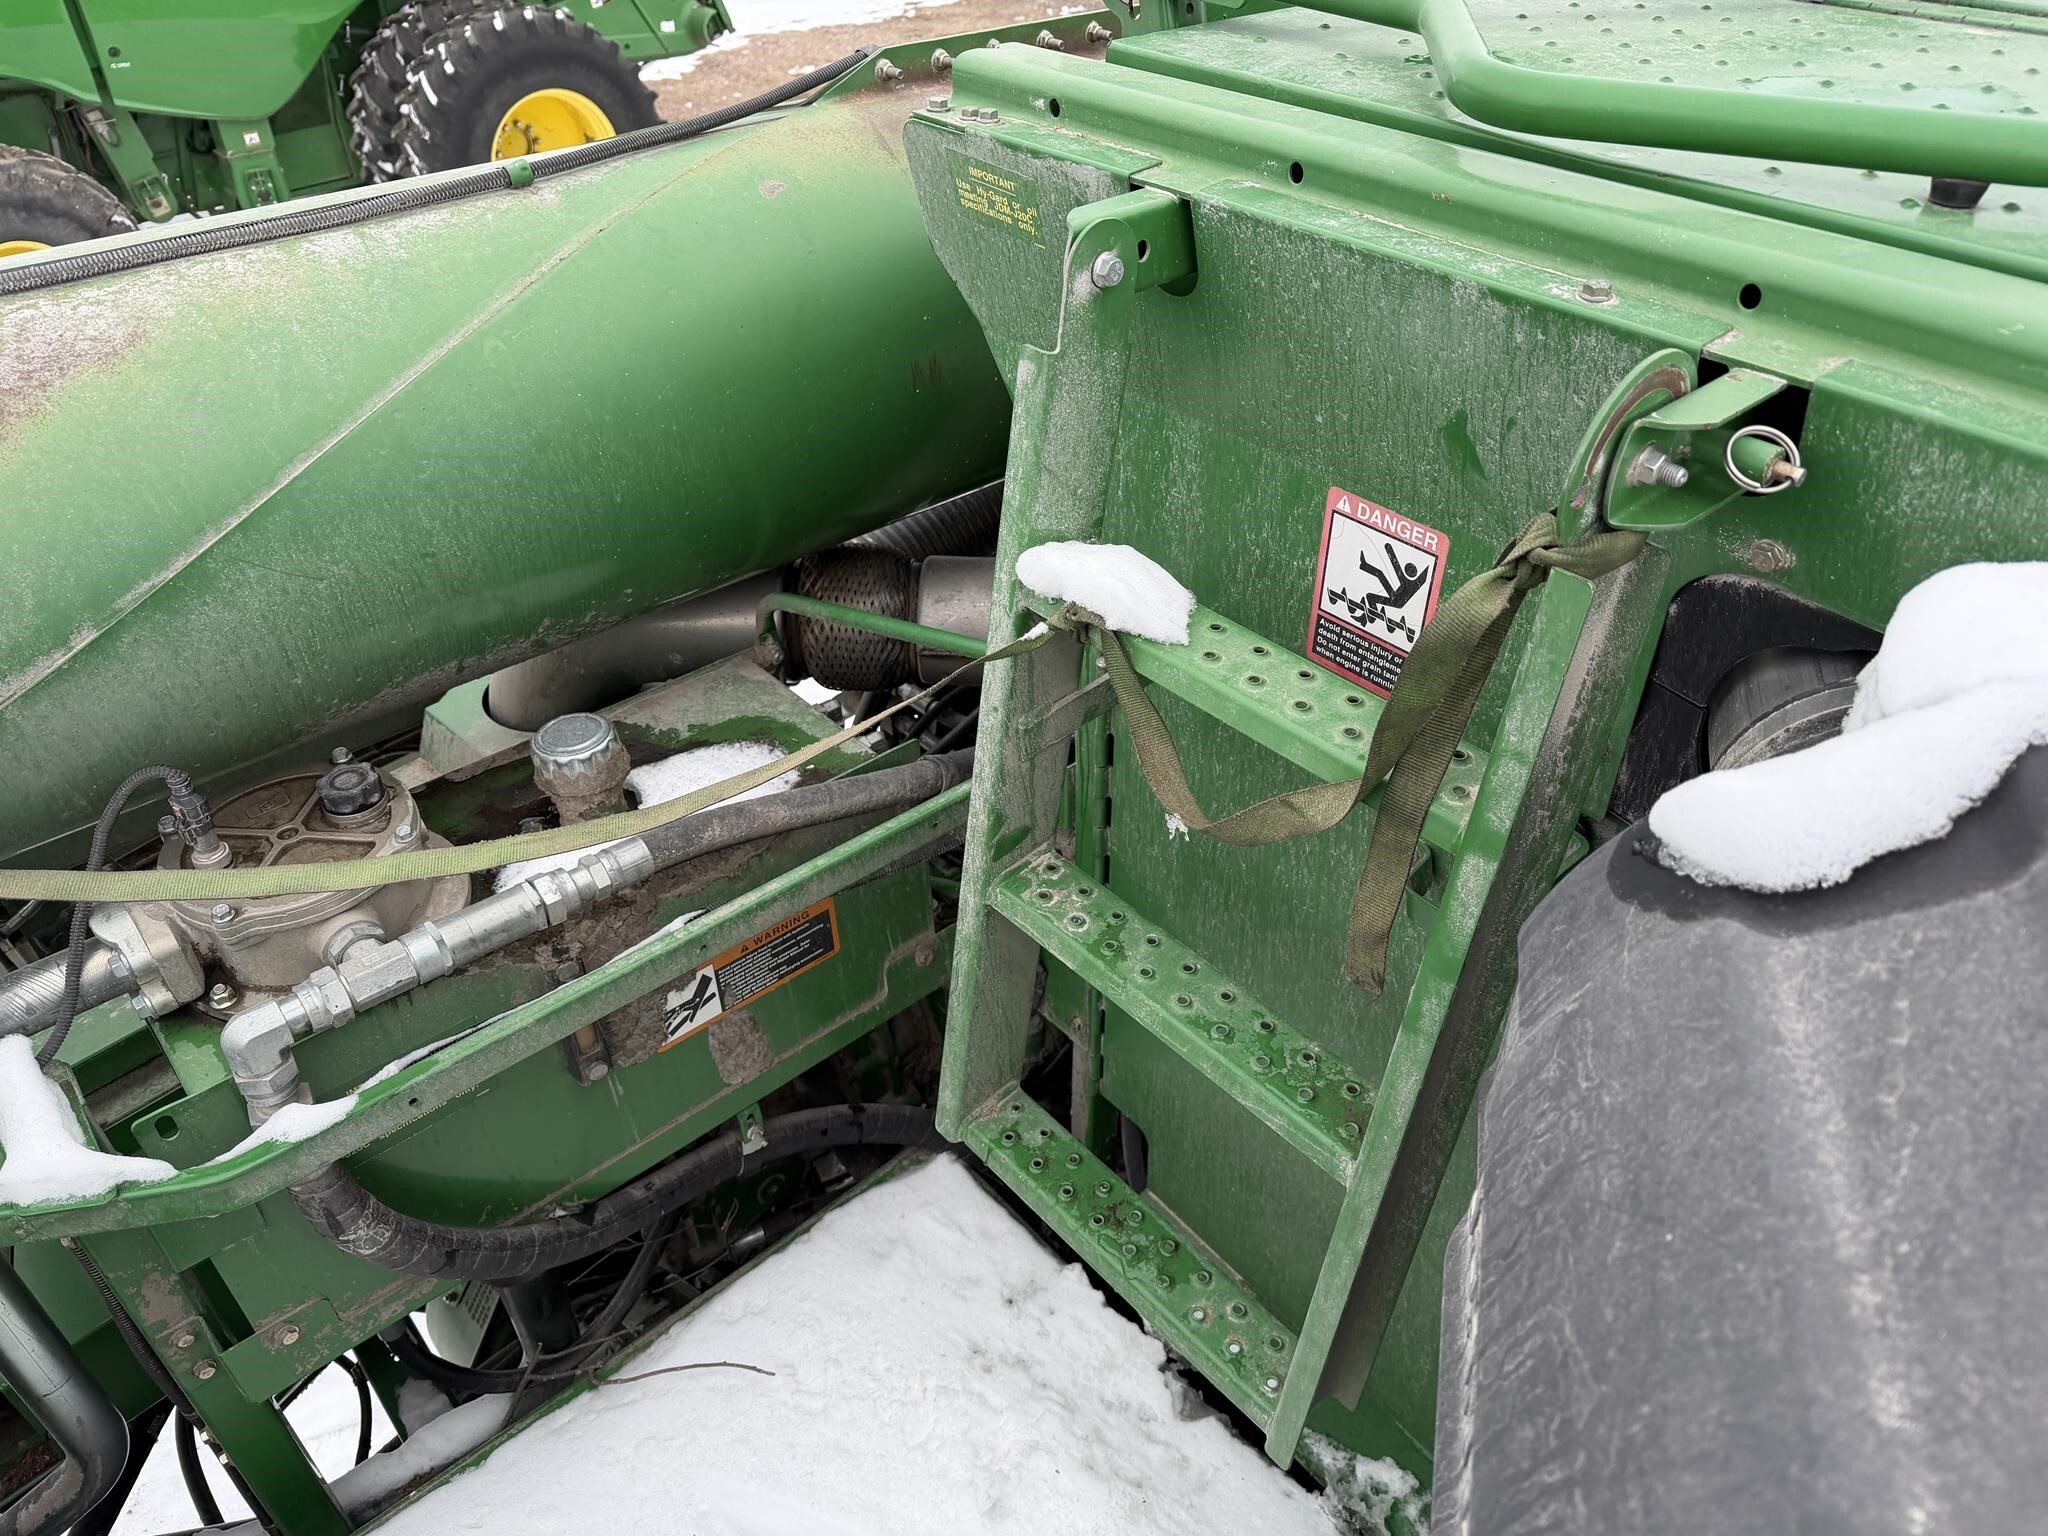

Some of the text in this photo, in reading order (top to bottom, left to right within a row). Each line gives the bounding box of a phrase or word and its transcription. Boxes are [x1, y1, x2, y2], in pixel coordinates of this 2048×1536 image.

[956, 178, 1037, 217] Use Hy-Gard or oil
[968, 166, 1016, 191] IMPORTANT
[958, 189, 1033, 223] meeting JDM-J20C
[960, 198, 1012, 224] specifications
[1356, 501, 1438, 551] DANGER
[1317, 636, 1327, 646] Do
[1328, 641, 1340, 652] not
[1342, 649, 1360, 662] enter
[1362, 661, 1381, 674] grain
[1318, 627, 1401, 673] death from entangleme
[1320, 618, 1403, 664] Avoid serious injury or
[1315, 645, 1394, 689] when engine is runnin
[753, 910, 810, 947] WARNING
